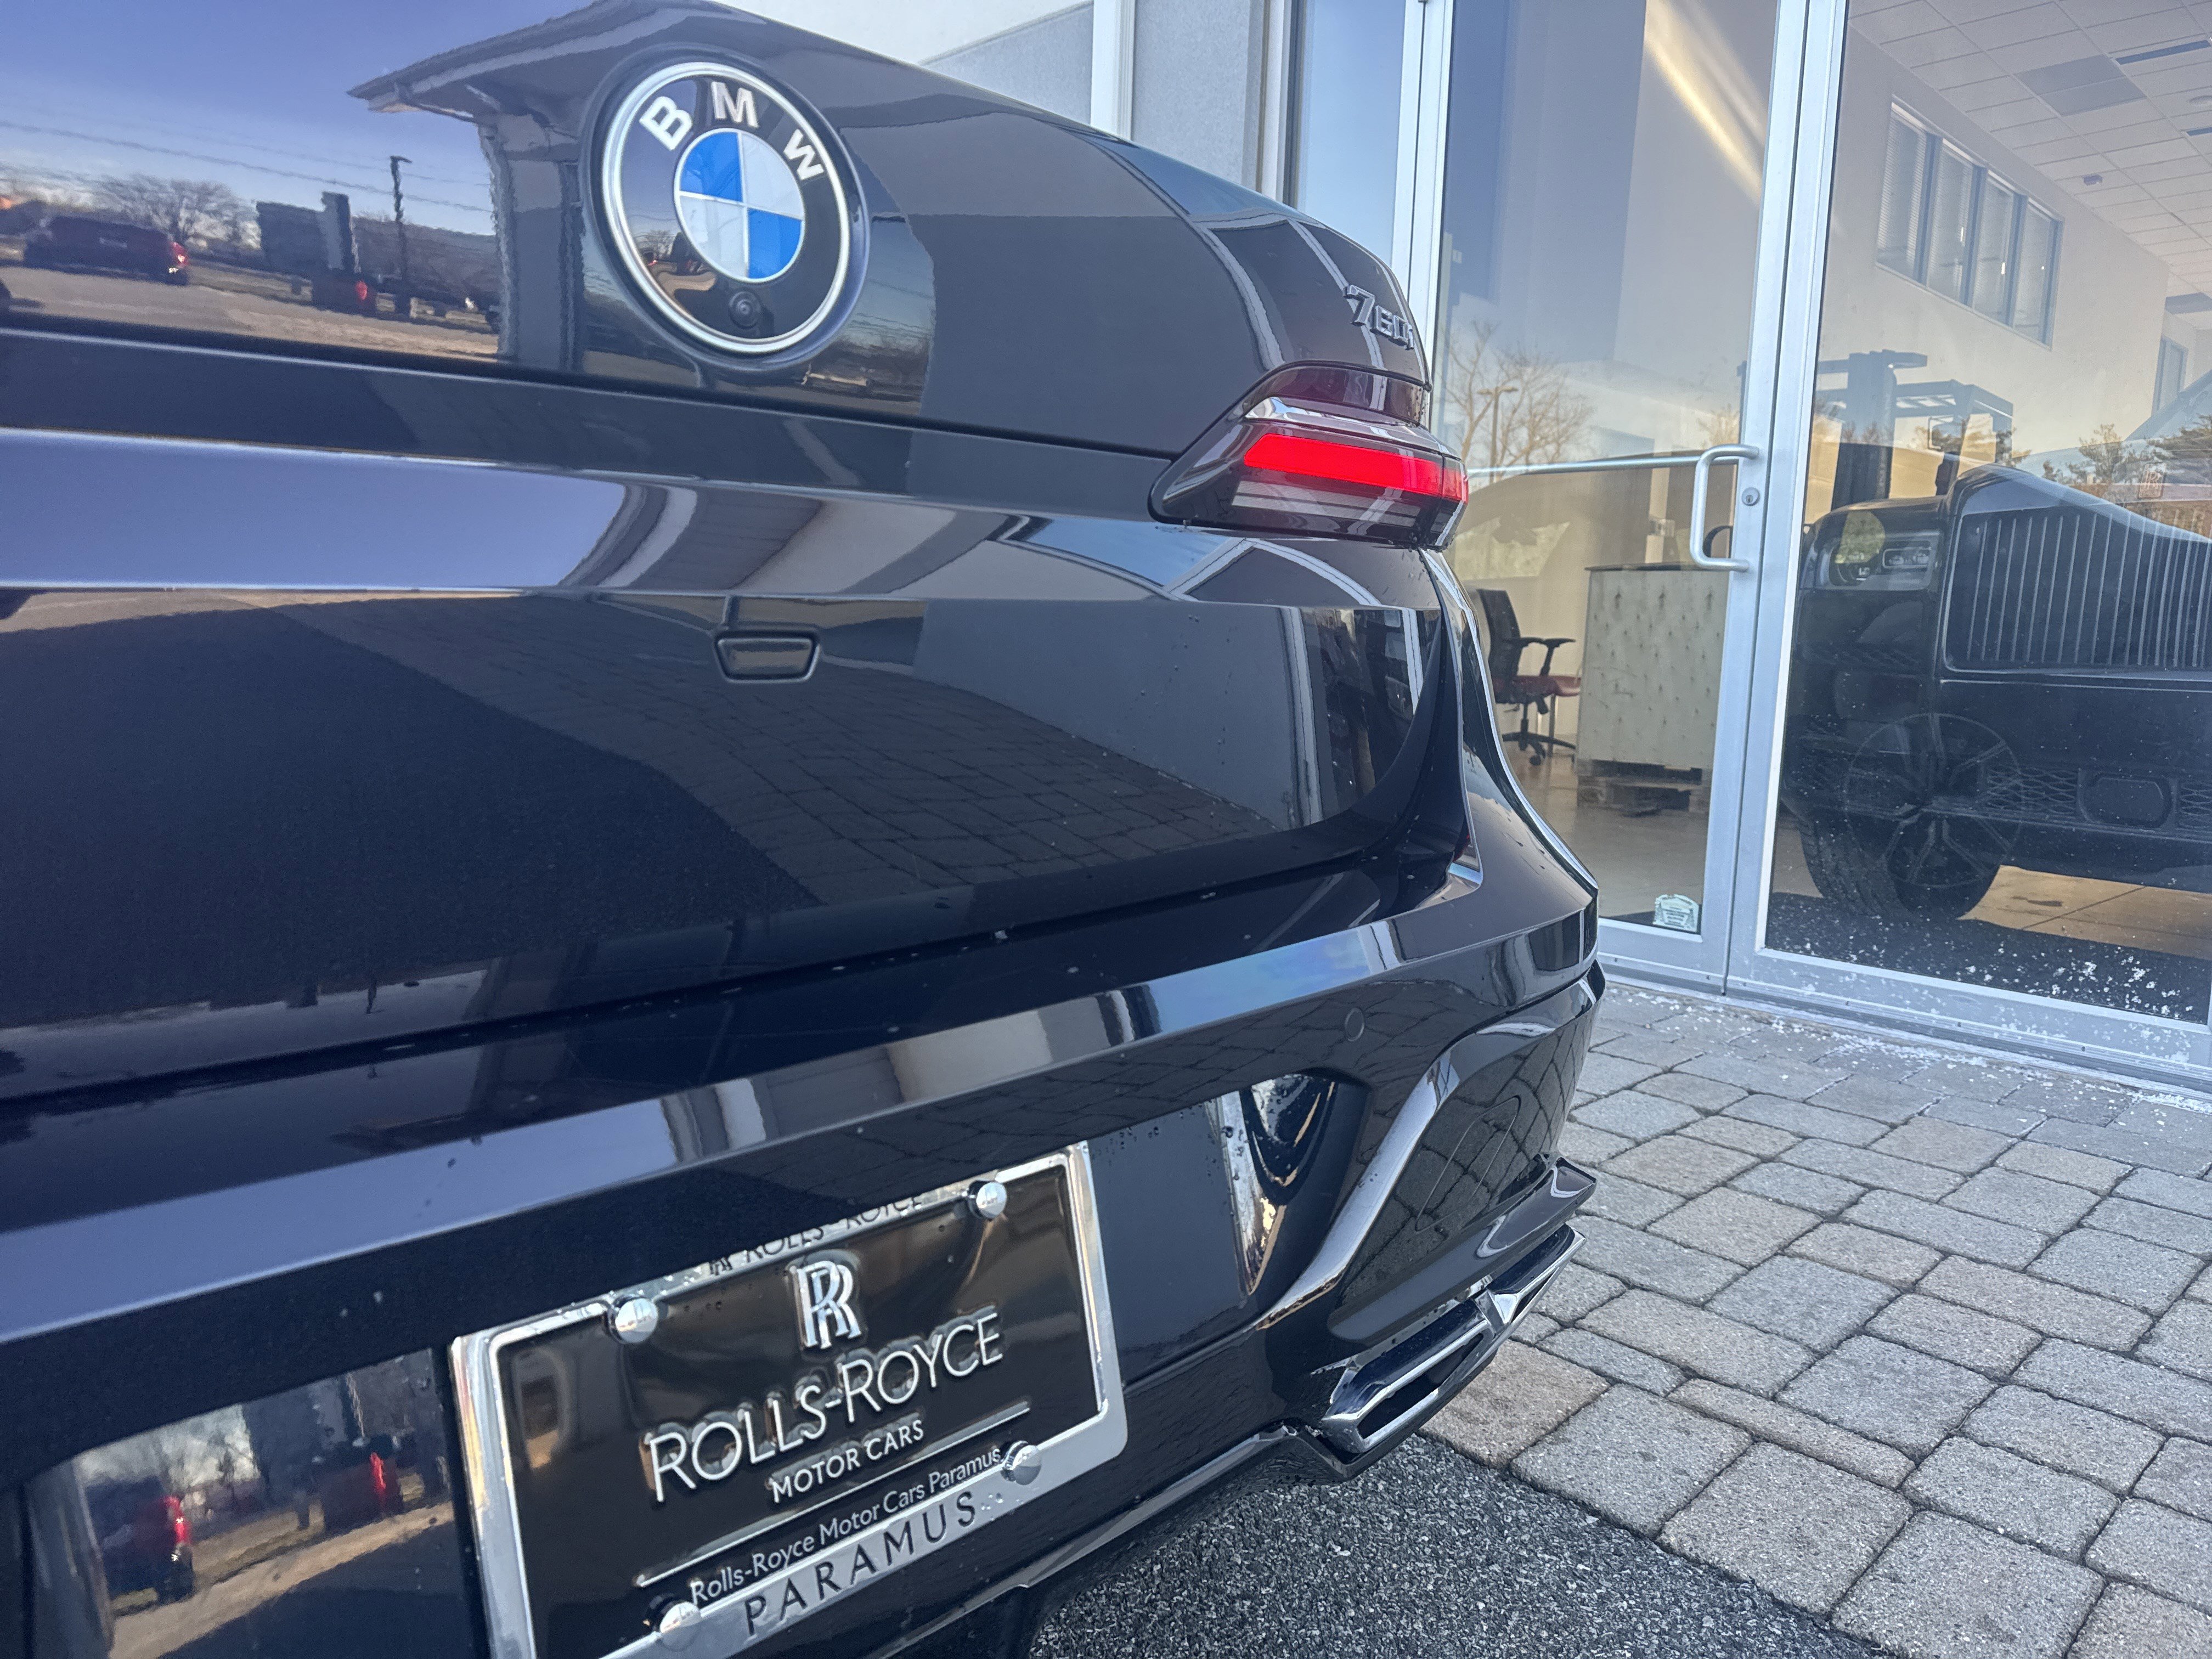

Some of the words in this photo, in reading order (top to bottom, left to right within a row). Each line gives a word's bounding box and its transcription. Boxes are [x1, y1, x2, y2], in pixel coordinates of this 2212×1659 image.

[640, 81, 824, 181] BMW
[1342, 284, 1414, 350] 760i
[649, 1312, 1003, 1503] ROLLS-ROYCE
[772, 1448, 861, 1503] MOTOR
[864, 1419, 924, 1461] CARS
[690, 1536, 814, 1606] Rolls-Royce
[819, 1503, 881, 1546] Motor
[882, 1482, 925, 1513] Cars
[928, 1448, 1001, 1494] Paramus
[744, 1491, 976, 1636] PARAMUS
